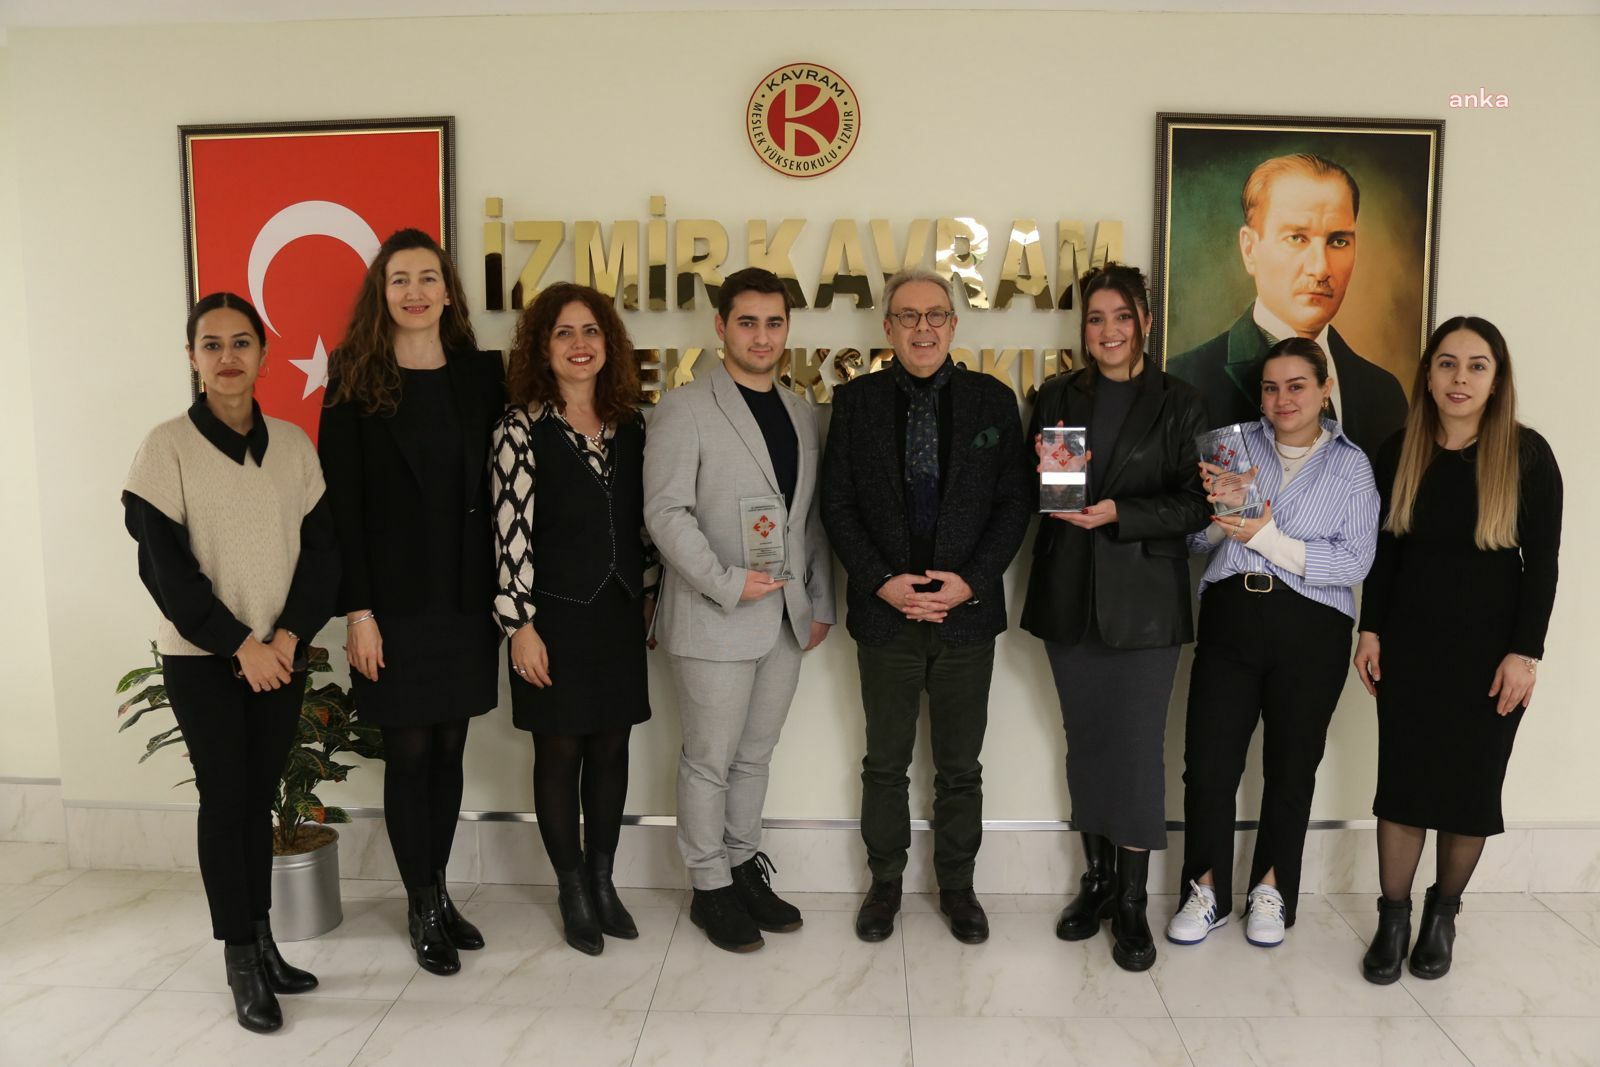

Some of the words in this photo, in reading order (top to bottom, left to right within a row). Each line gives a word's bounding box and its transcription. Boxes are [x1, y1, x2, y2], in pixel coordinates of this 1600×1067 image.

[766, 69, 845, 98] KAVRAM
[751, 102, 767, 146] MESLEK
[763, 145, 838, 171] YÜKSEKOKULU
[839, 110, 854, 144] İZMİR
[484, 196, 728, 311] İZMİR
[746, 217, 1123, 310] KAVRAM
